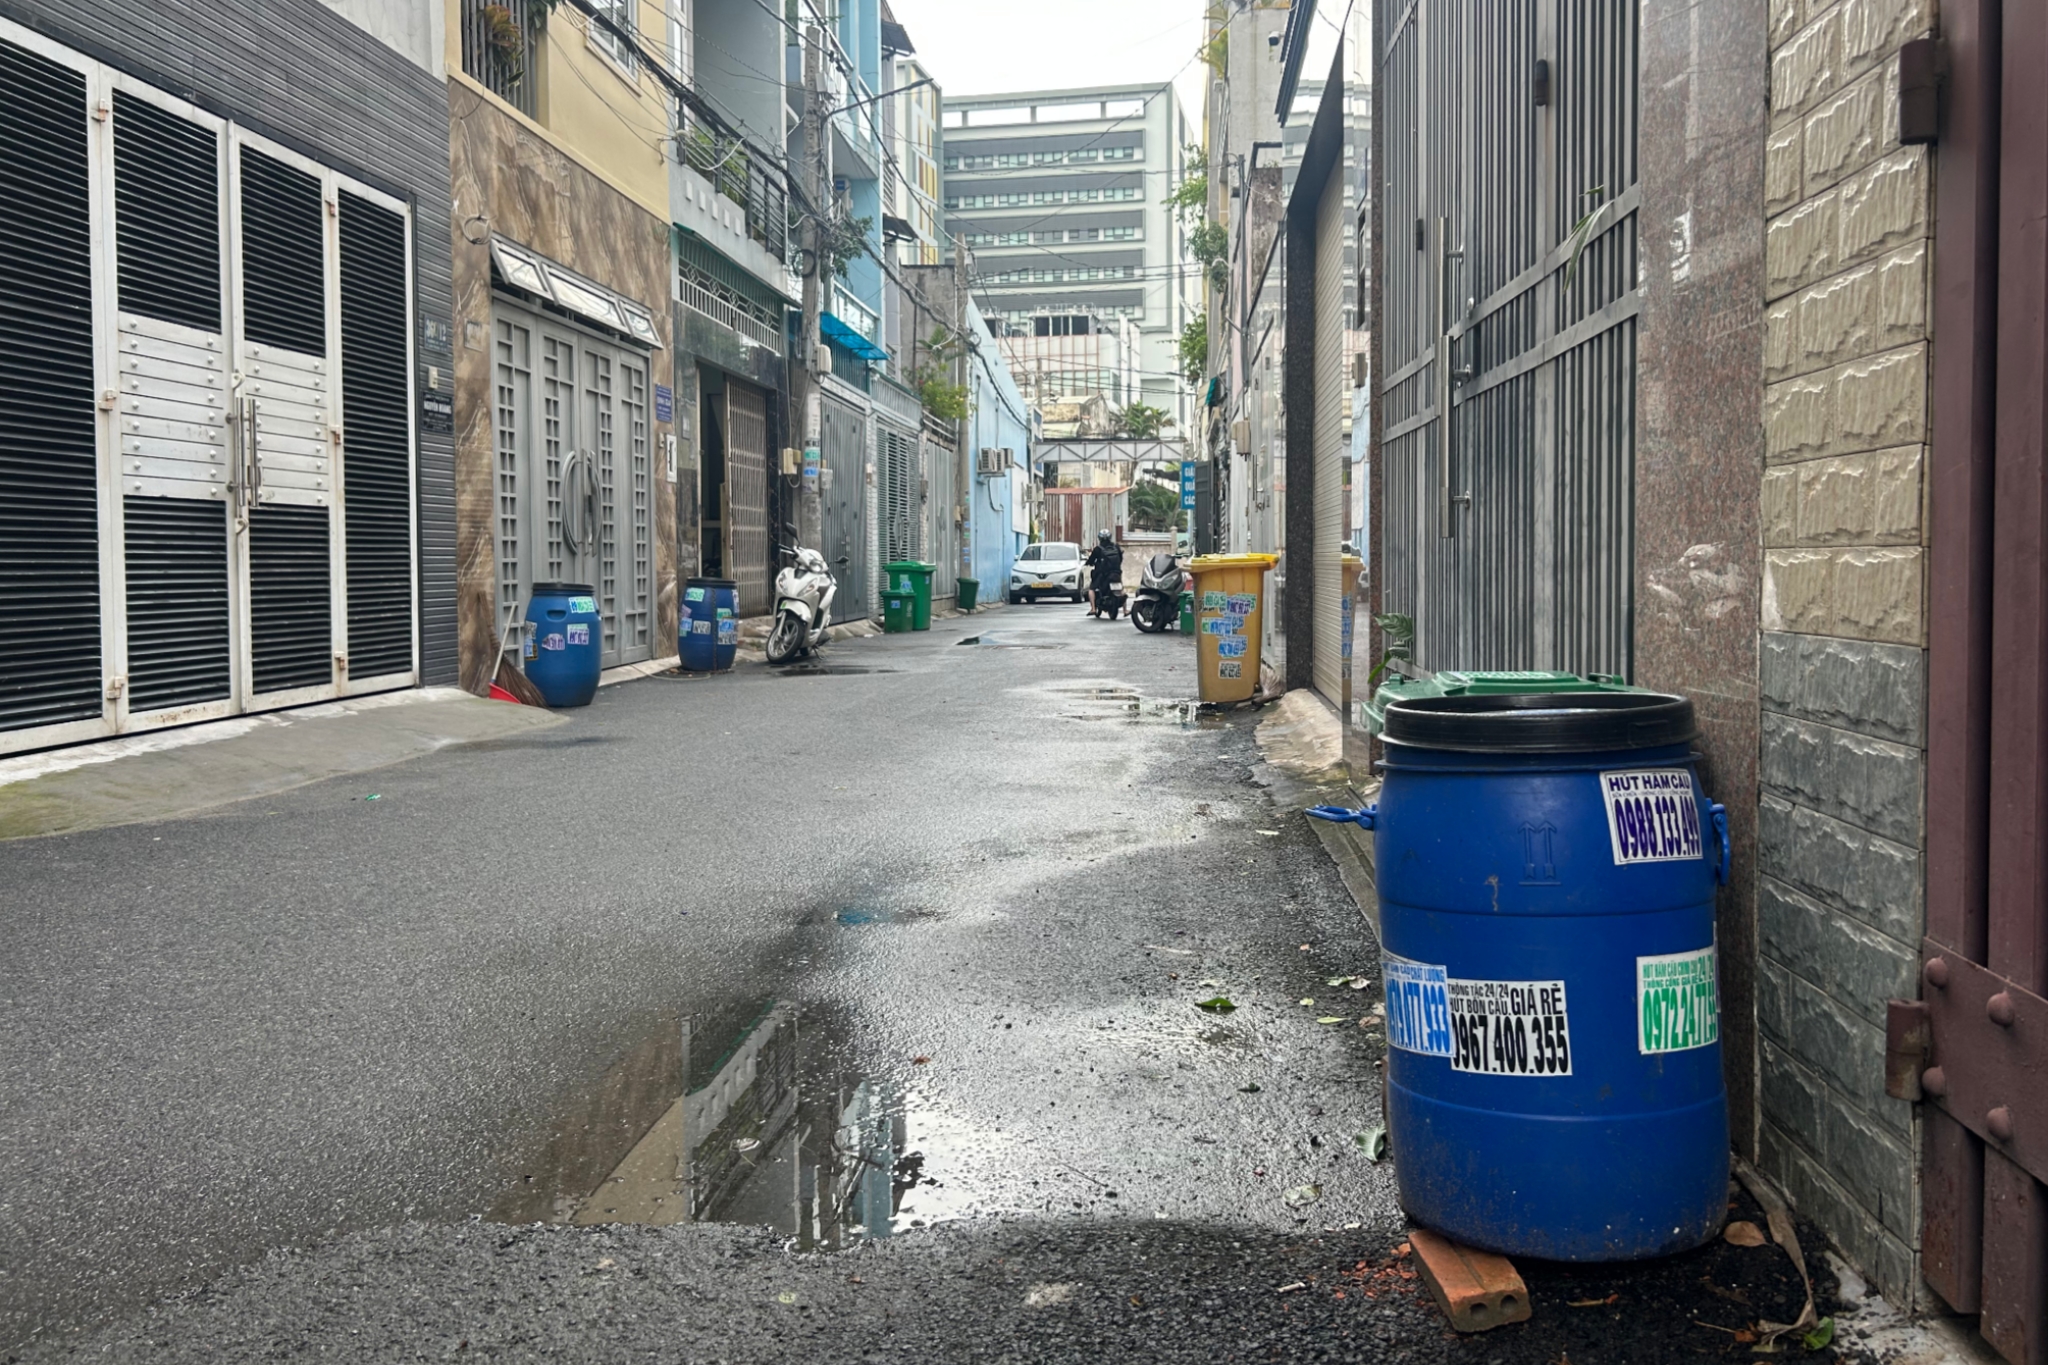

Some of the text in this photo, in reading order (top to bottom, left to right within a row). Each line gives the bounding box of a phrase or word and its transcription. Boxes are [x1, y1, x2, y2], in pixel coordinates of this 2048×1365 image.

[1608, 772, 1691, 791] HÚT HẦM CẦU
[1614, 795, 1701, 859] 0988.133.499
[1484, 983, 1509, 998] 24/24
[1510, 983, 1563, 1016] GIÁ RẺ
[1449, 996, 1464, 1013] HÚT
[1467, 996, 1486, 1014] BỒN
[1451, 1012, 1569, 1074] 0967.400.355
